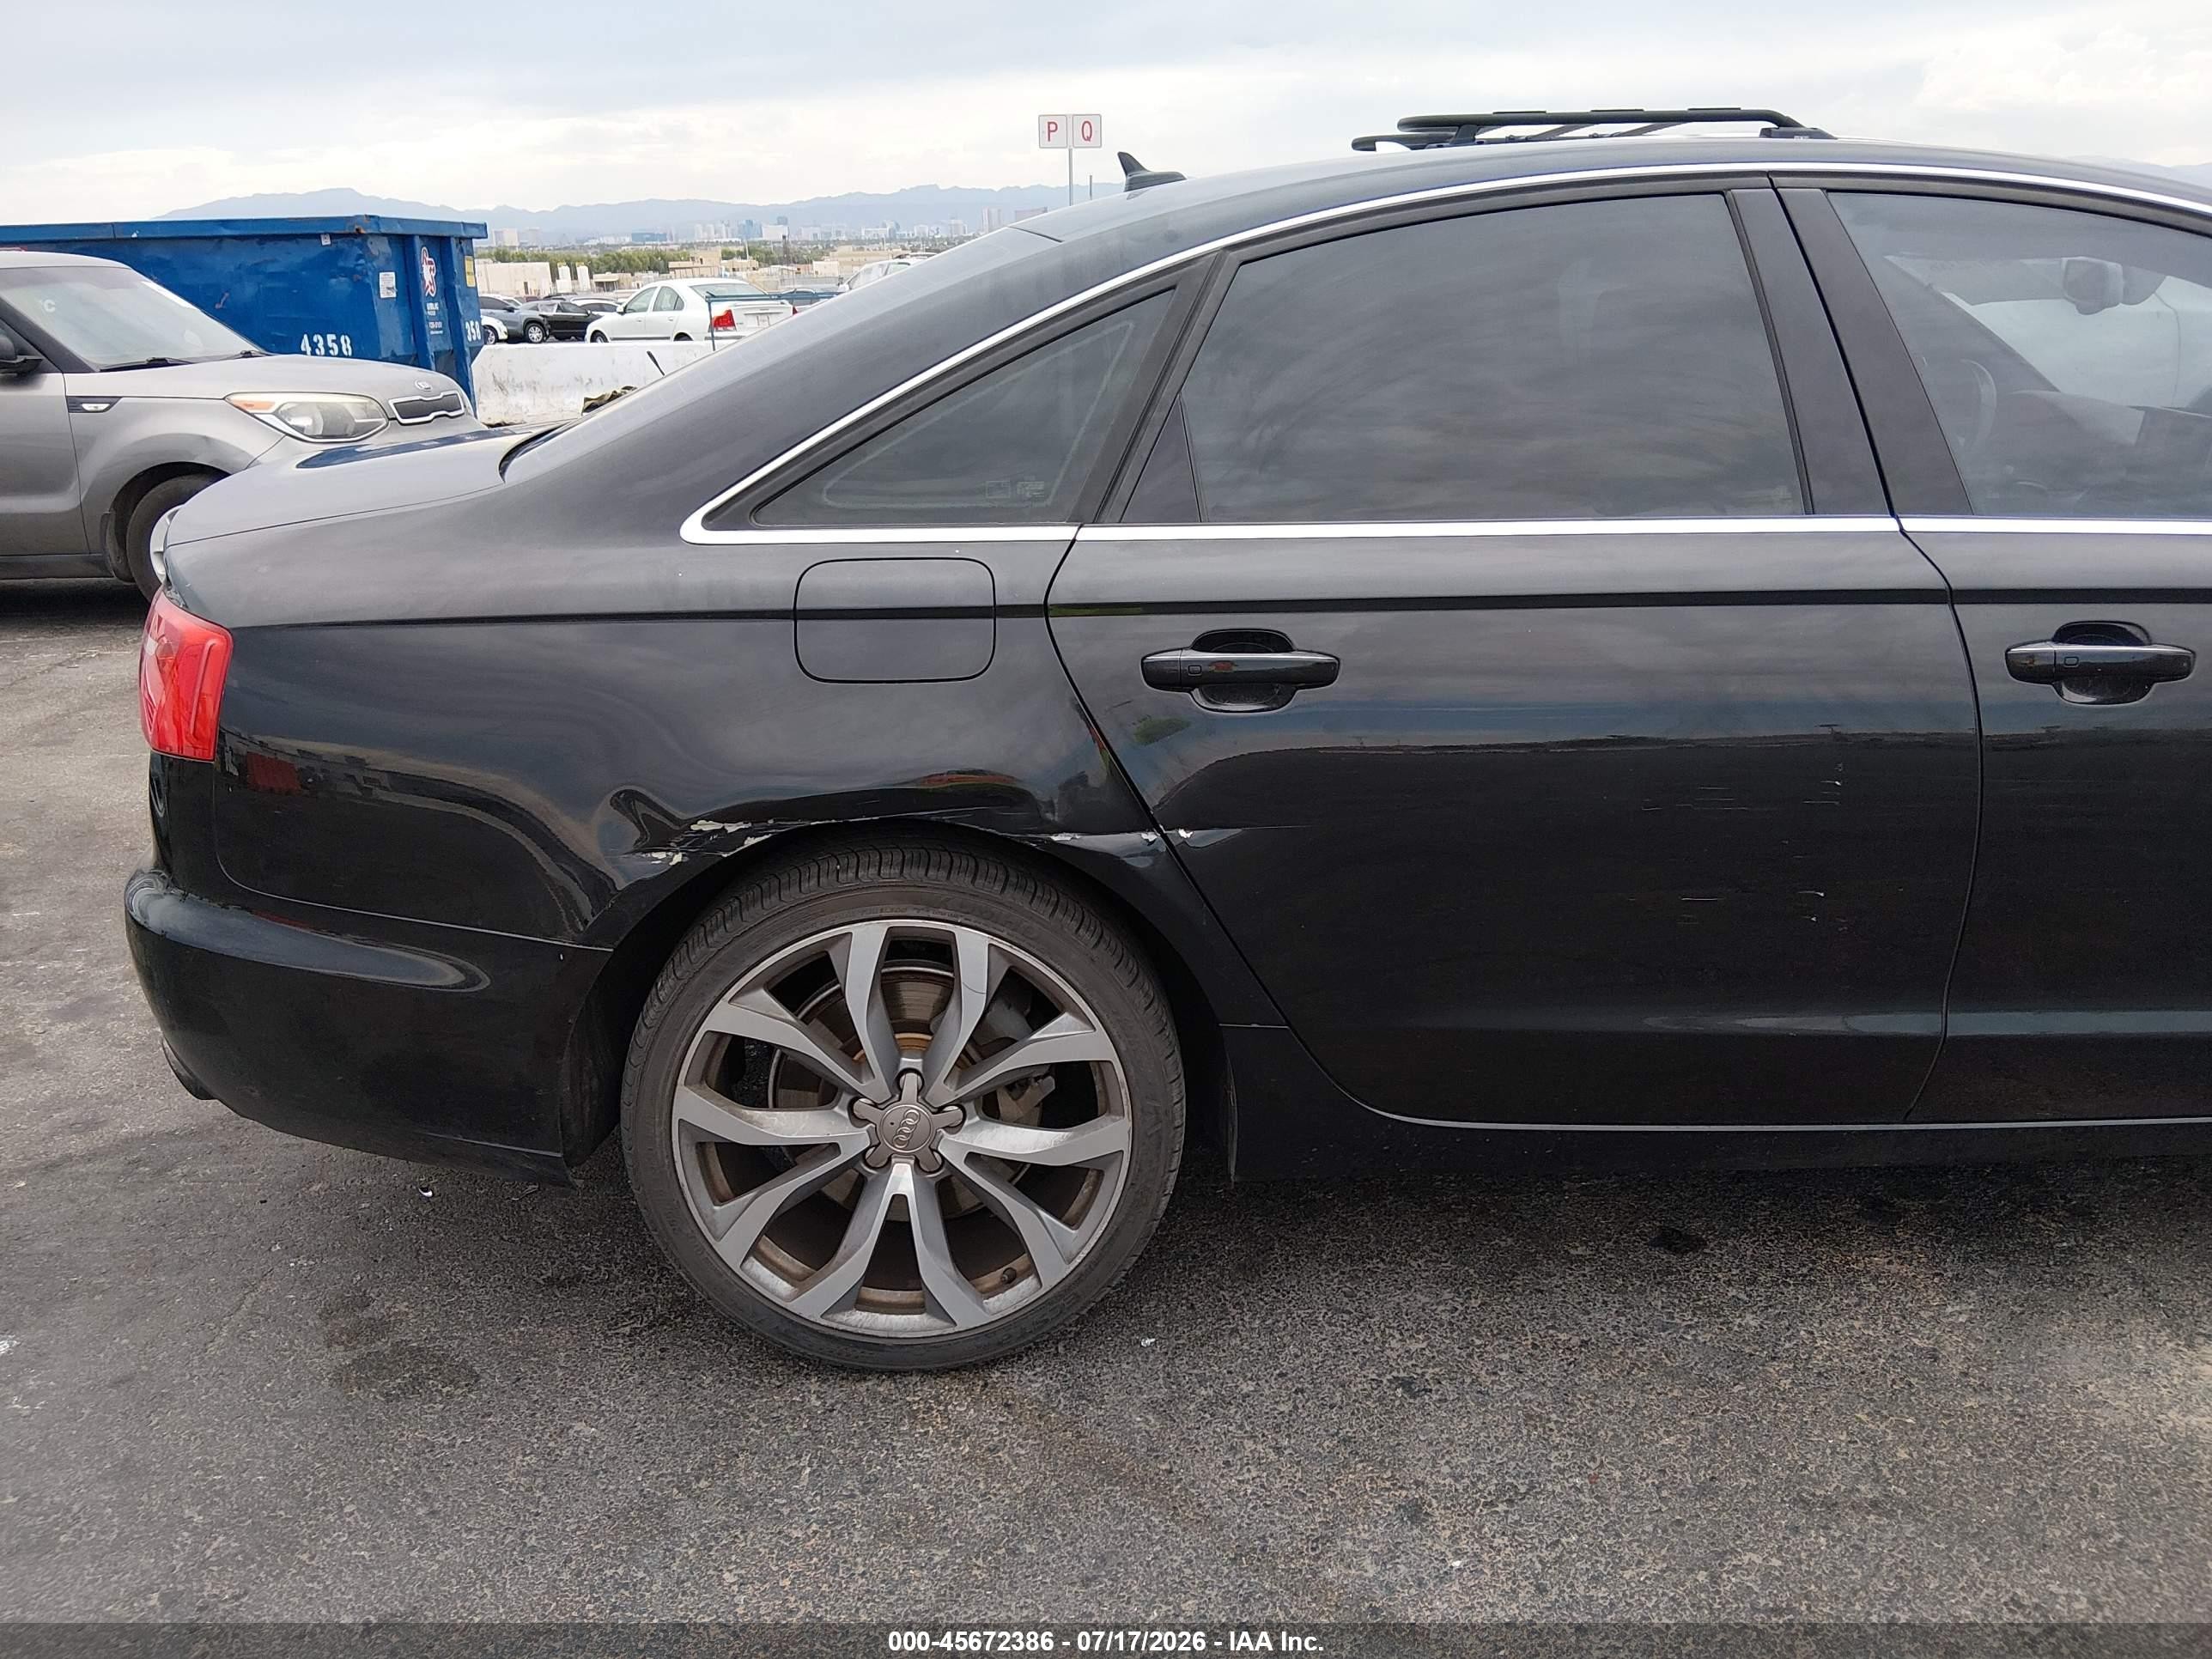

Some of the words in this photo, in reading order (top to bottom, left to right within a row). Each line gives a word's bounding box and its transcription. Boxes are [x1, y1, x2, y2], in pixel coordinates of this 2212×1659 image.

[1047, 121, 1058, 142] P
[1081, 120, 1092, 142] Q
[301, 333, 352, 356] 4358
